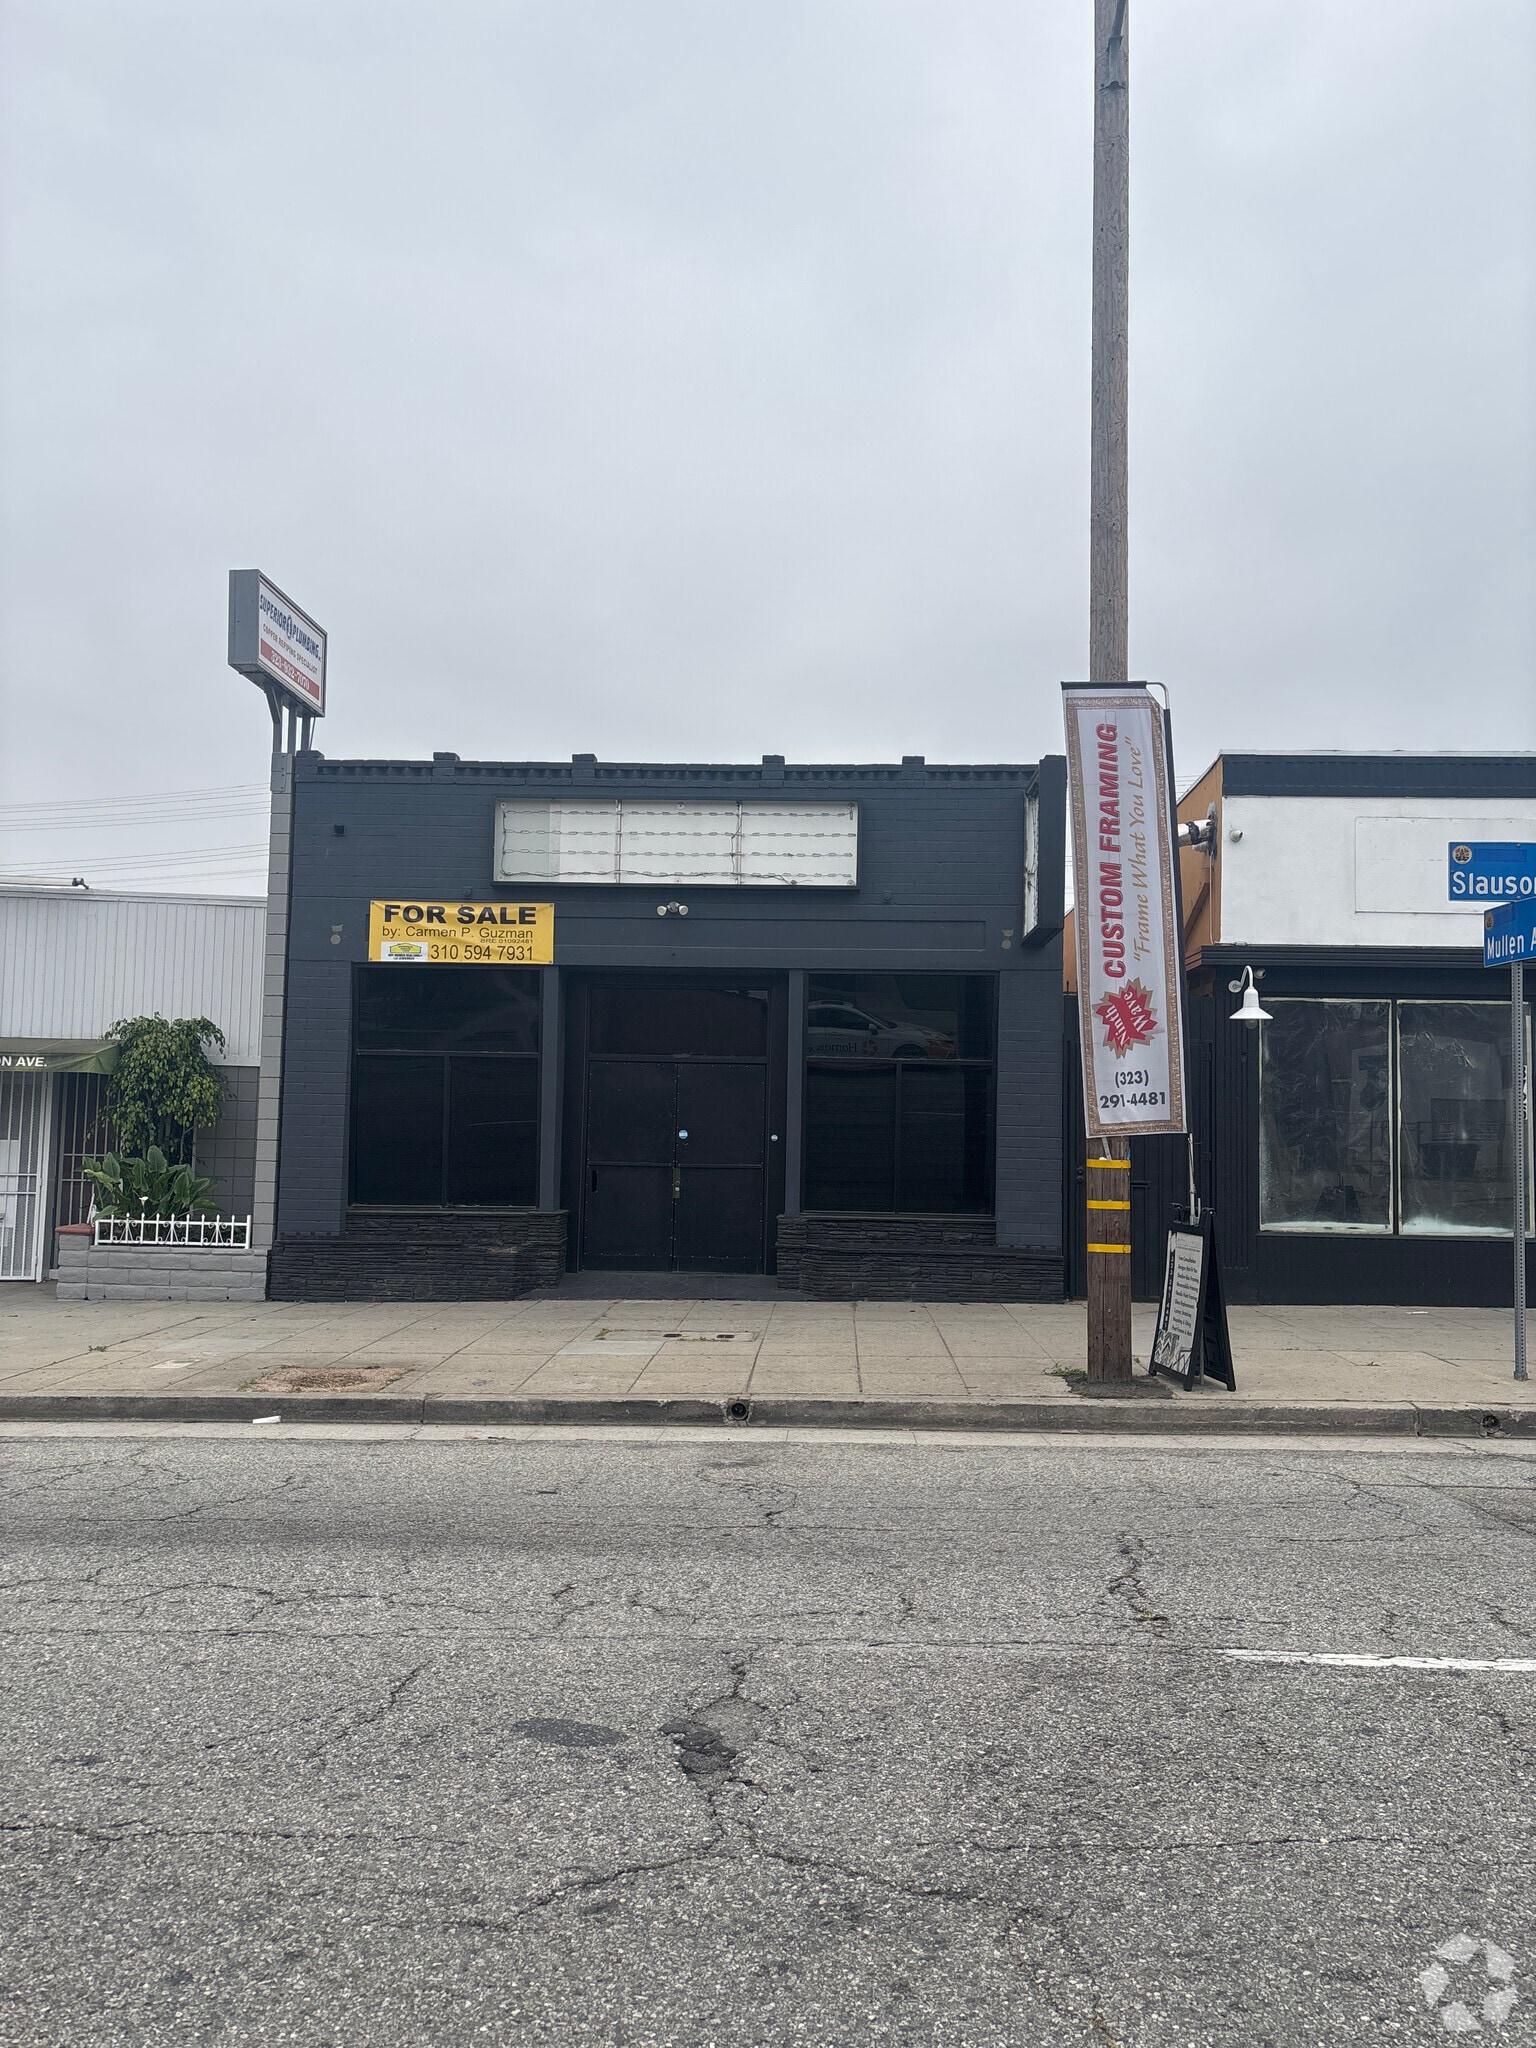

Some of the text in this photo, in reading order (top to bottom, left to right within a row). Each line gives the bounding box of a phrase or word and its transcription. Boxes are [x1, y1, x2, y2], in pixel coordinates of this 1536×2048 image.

[259, 594, 287, 632] SUPERIOR
[1128, 794, 1146, 829] You
[1095, 723, 1126, 979] CUSTOM FRAMING
[1128, 831, 1149, 889] What
[1452, 870, 1536, 895] Slauso
[384, 904, 537, 925] FOR SALE
[382, 925, 533, 939] by: Carmen P. Guzman
[430, 944, 459, 960] 310
[463, 944, 492, 960] 594
[497, 945, 533, 961] 7931
[1487, 934, 1525, 960] Mullen
[1123, 991, 1149, 1033] Wave
[1104, 1004, 1131, 1047] Ninth
[0, 1056, 47, 1067] N AVE.
[1115, 1069, 1149, 1089] (323)
[1099, 1091, 1166, 1109] 291-4481
